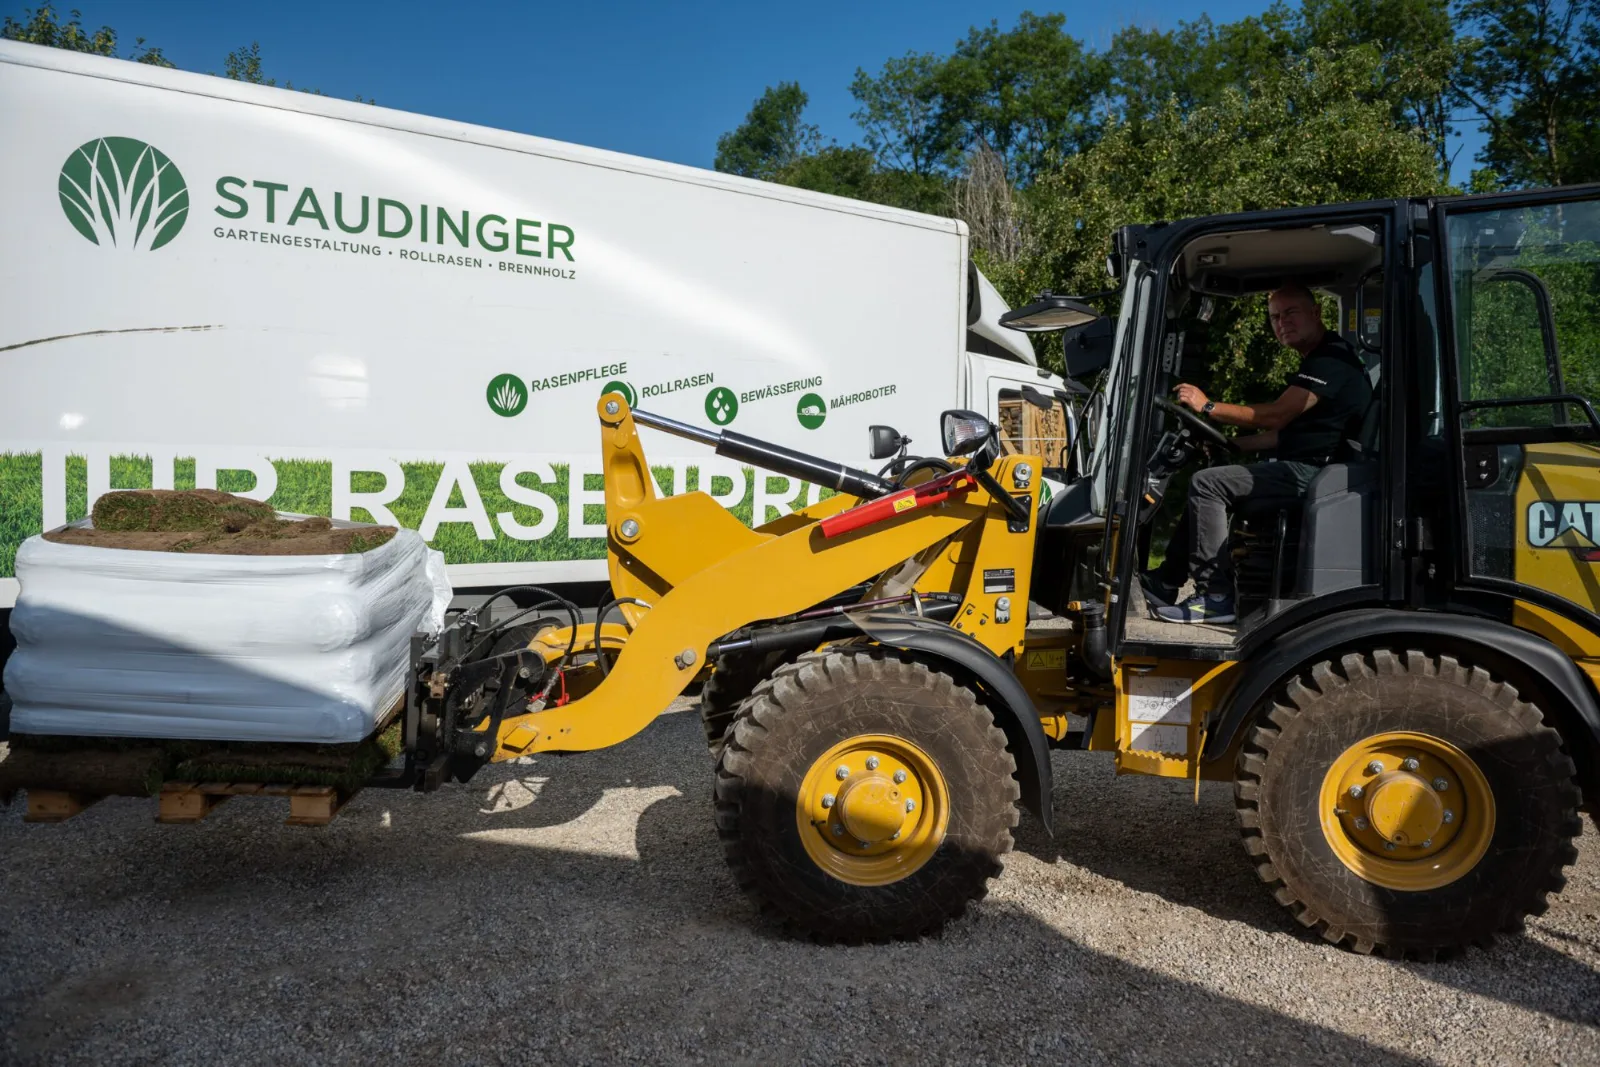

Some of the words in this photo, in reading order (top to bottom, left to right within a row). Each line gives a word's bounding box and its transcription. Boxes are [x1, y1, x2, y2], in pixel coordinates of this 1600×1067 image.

[214, 175, 576, 262] STAUDINGER
[213, 226, 382, 256] GARTENGESTALTUNG
[400, 248, 482, 269] ROLLRASEN
[498, 261, 576, 280] BRENNHOLZ
[531, 362, 628, 392] RASENPFLEGE
[642, 372, 715, 399] ROLLRASEN
[740, 375, 823, 404] BEWÄSSERUNG
[830, 384, 897, 410] MÄHROBOTER
[1528, 502, 1600, 548] CAT
